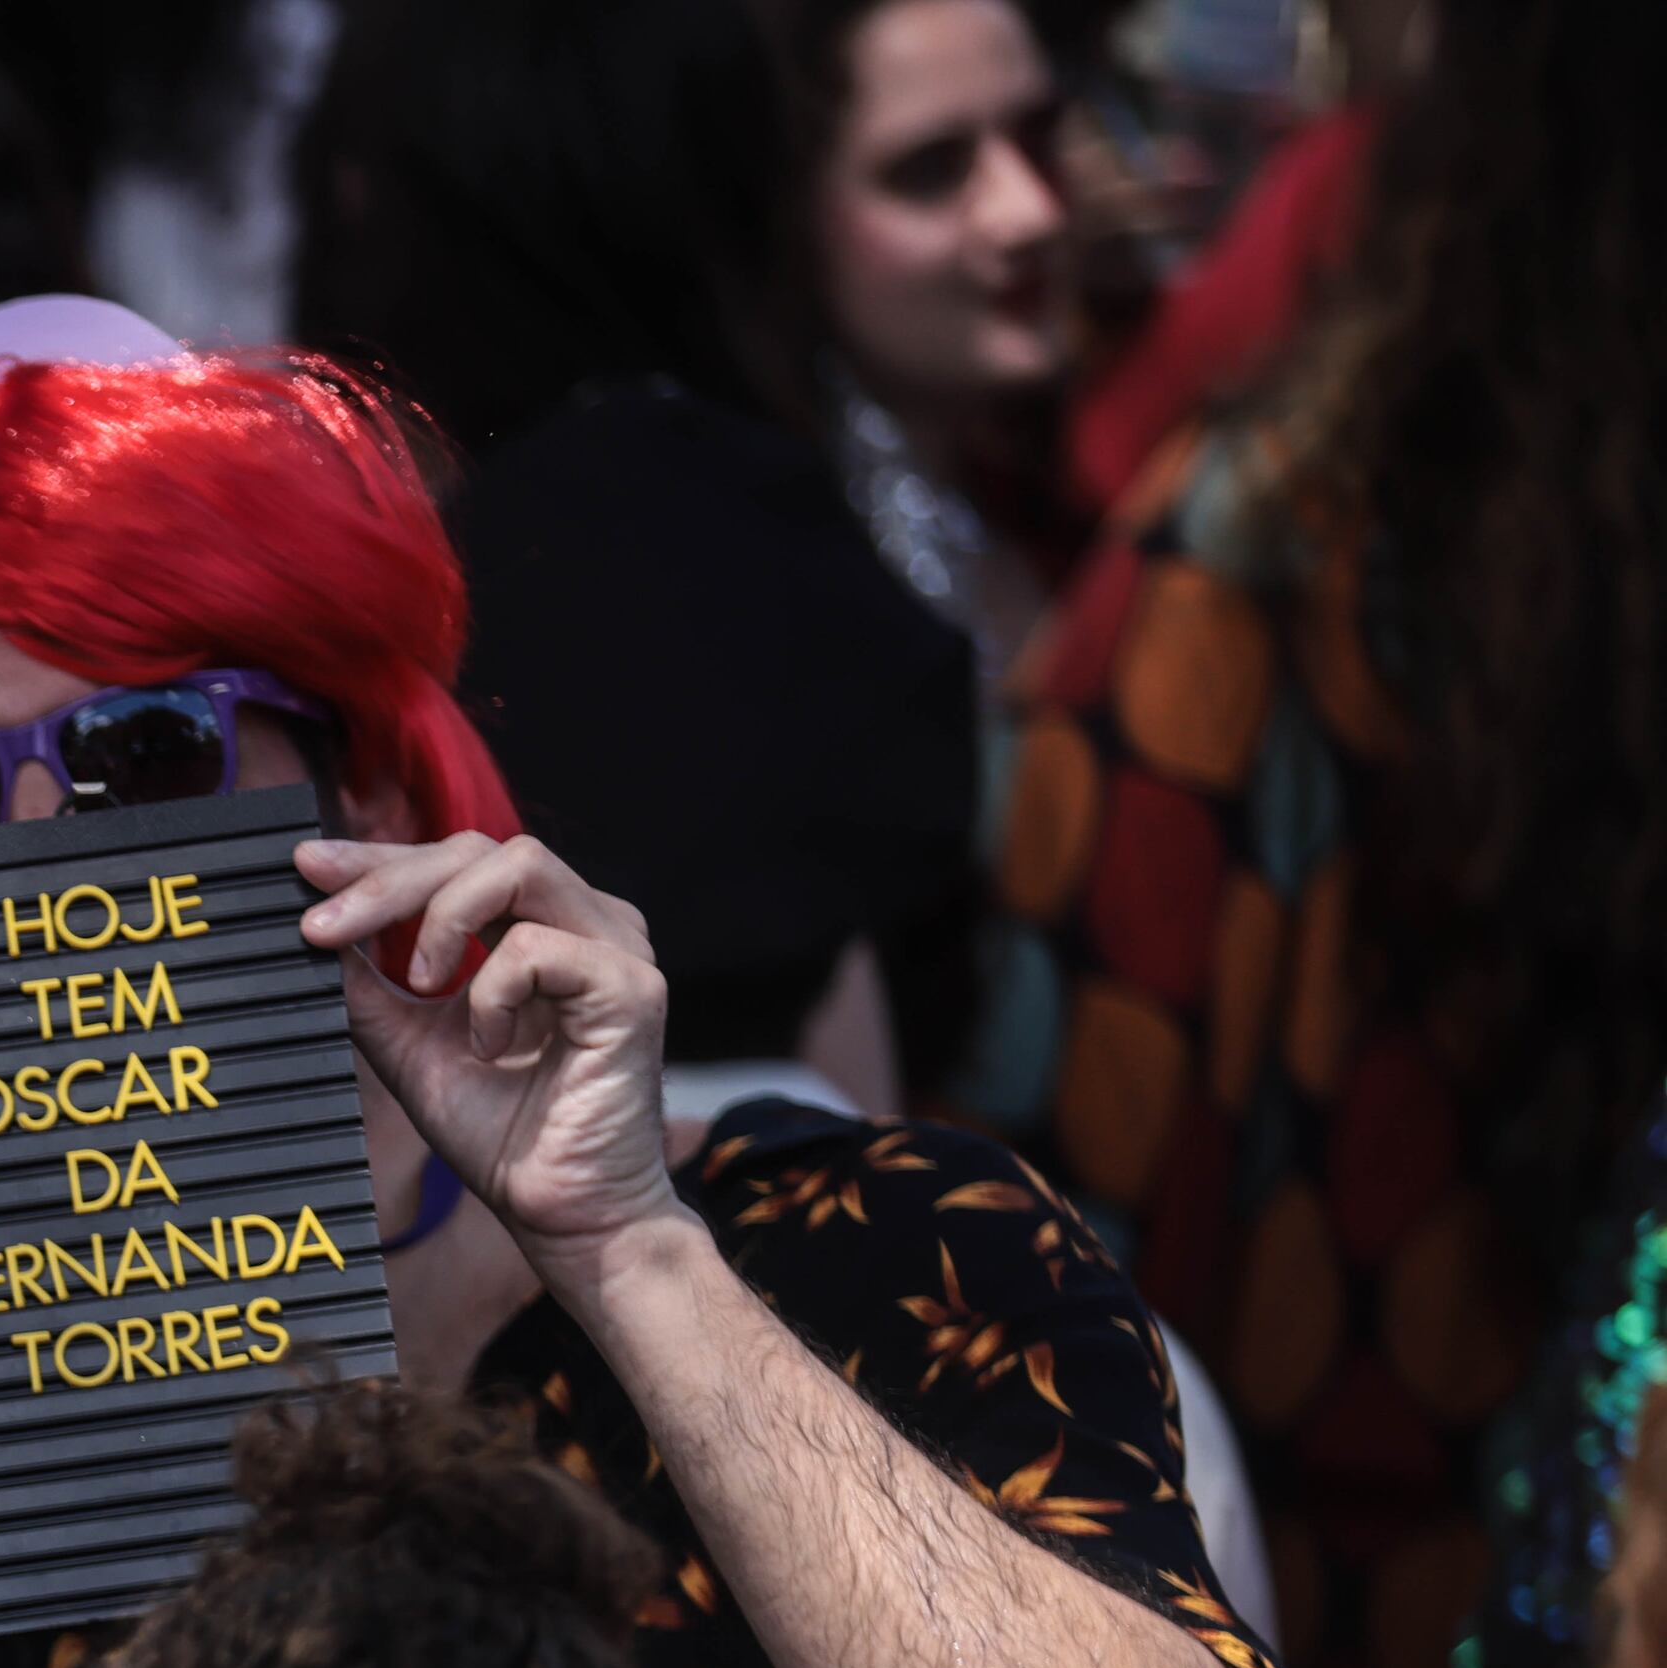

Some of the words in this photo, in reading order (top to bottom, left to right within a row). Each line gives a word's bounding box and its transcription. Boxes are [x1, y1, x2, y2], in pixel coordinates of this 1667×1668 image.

[2, 875, 210, 958] HOJE
[20, 963, 183, 1040] TEM
[65, 1139, 180, 1214] DA
[10, 1297, 292, 1393] TORRES
